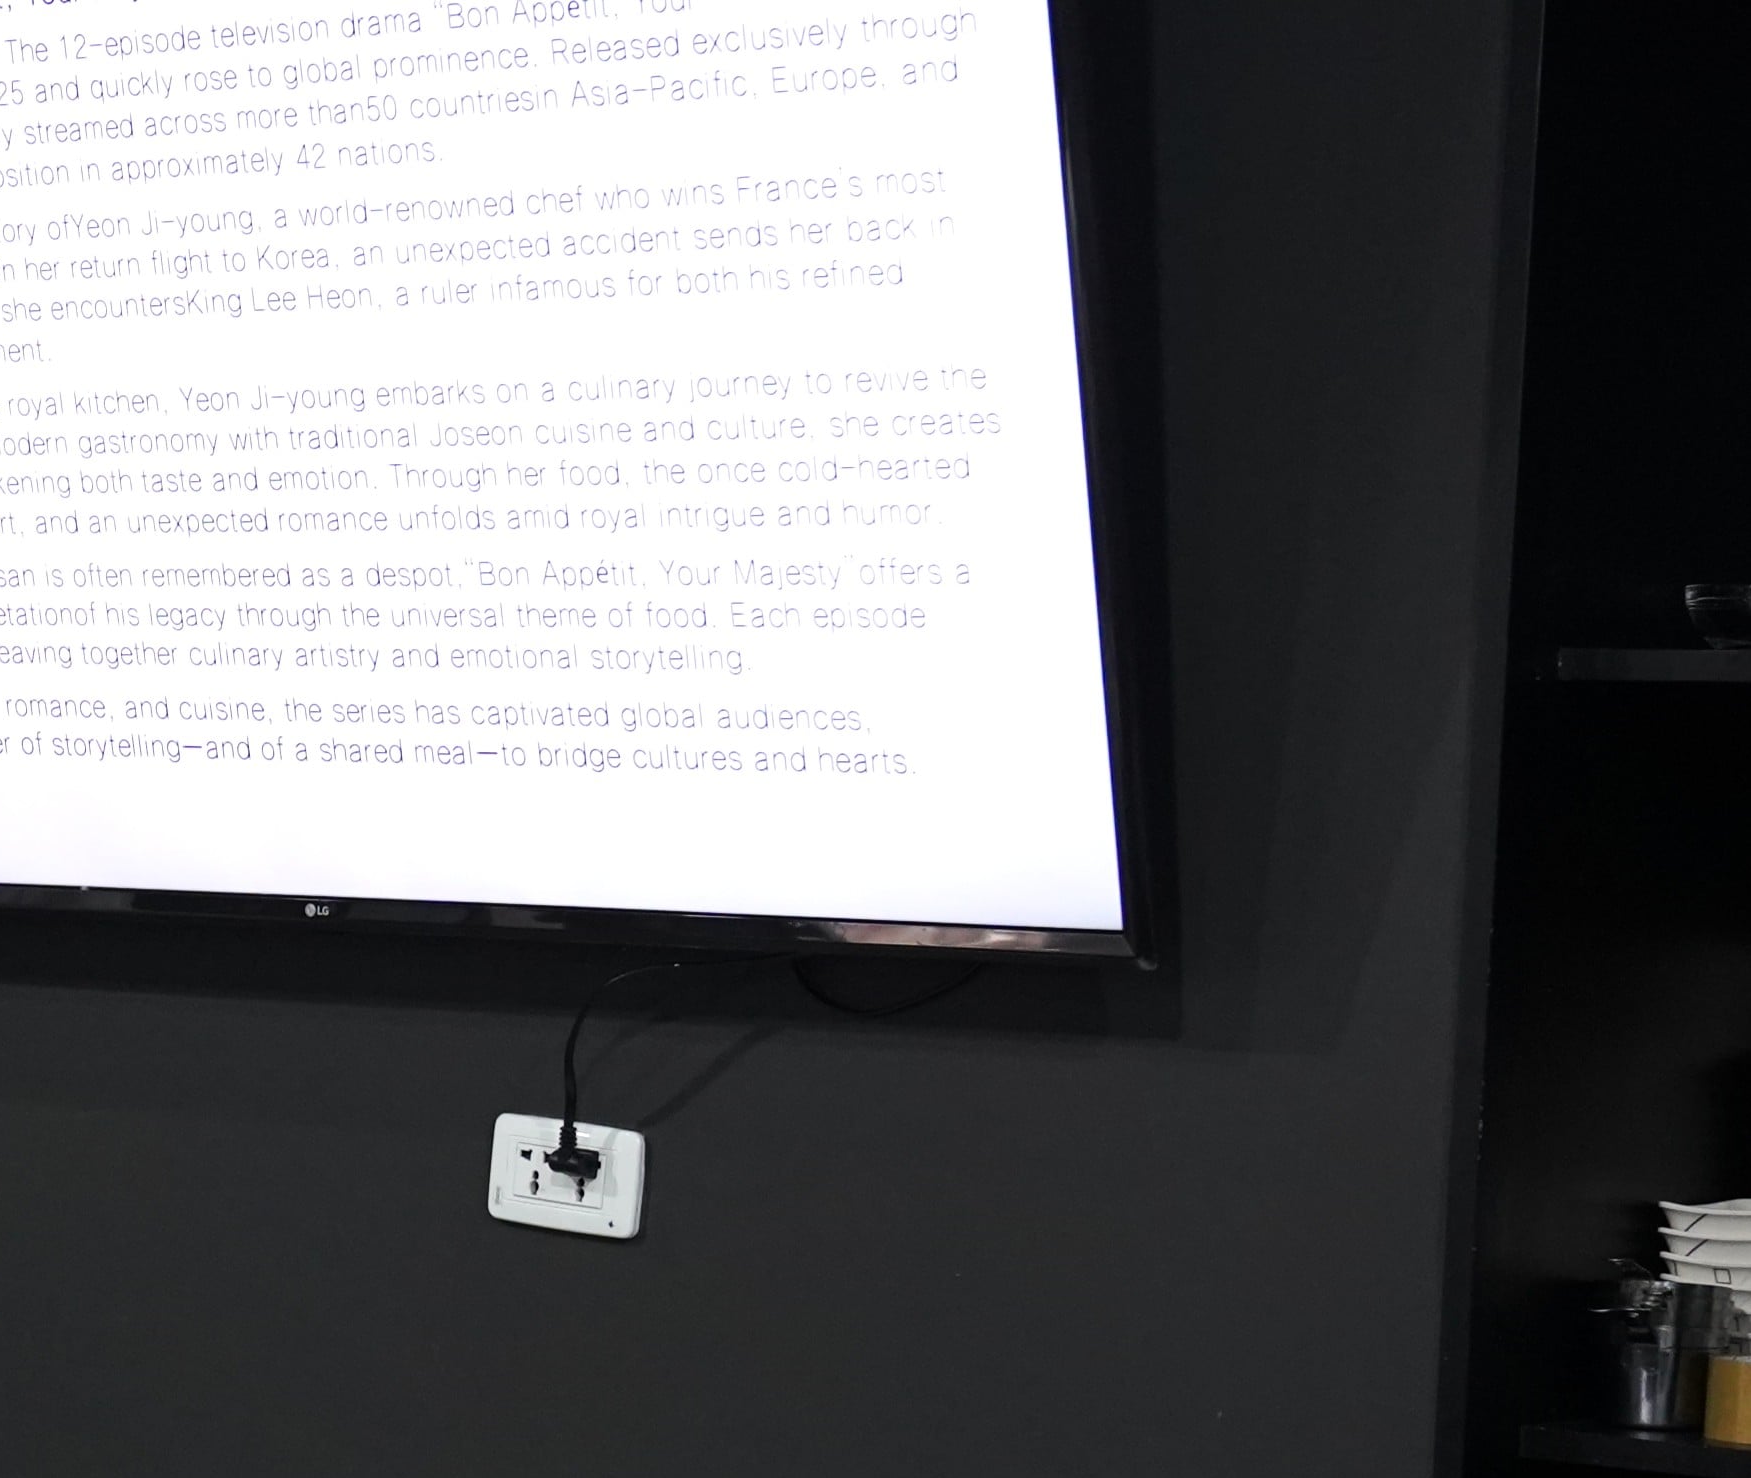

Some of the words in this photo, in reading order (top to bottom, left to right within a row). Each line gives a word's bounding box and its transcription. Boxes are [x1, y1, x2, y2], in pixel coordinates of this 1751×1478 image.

[3, 37, 50, 65] The
[209, 18, 330, 49] television
[341, 5, 423, 38] drama
[23, 111, 135, 146] streamed
[143, 111, 228, 138] across
[236, 106, 299, 130] more
[307, 93, 398, 127] than50
[409, 87, 559, 120] countriesin
[901, 54, 959, 87] and
[79, 161, 102, 183] in
[110, 145, 284, 186] approximately
[295, 141, 327, 170] 42
[77, 430, 219, 460] gastronomy
[227, 424, 280, 452] with
[287, 421, 418, 451] traditional
[429, 422, 524, 448] Joseon
[534, 421, 633, 446] cuisine
[642, 415, 696, 443] and
[829, 410, 880, 439] she
[891, 411, 1003, 437] creates
[104, 601, 141, 628] his
[147, 602, 227, 633] legacy
[236, 601, 332, 633] through
[340, 601, 381, 629] the
[390, 601, 506, 629] universal
[515, 601, 598, 629] theme
[607, 600, 634, 629] of
[729, 600, 802, 630] Each
[812, 603, 927, 634] episode
[80, 640, 178, 671] together
[188, 641, 284, 672] culinary
[294, 643, 380, 673] artistry
[391, 642, 441, 669] and
[449, 643, 579, 671] emotional
[124, 695, 170, 721] and
[283, 696, 323, 724] the
[331, 702, 407, 725] series
[413, 698, 462, 726] has
[470, 700, 610, 732] captivated
[620, 701, 704, 733] global
[20, 730, 43, 757] of
[260, 735, 284, 762] of
[294, 741, 309, 763] a
[318, 736, 405, 765] shared
[536, 741, 622, 774] bridge
[631, 743, 744, 772] cultures
[754, 745, 808, 773] and
[316, 905, 330, 916] LG
